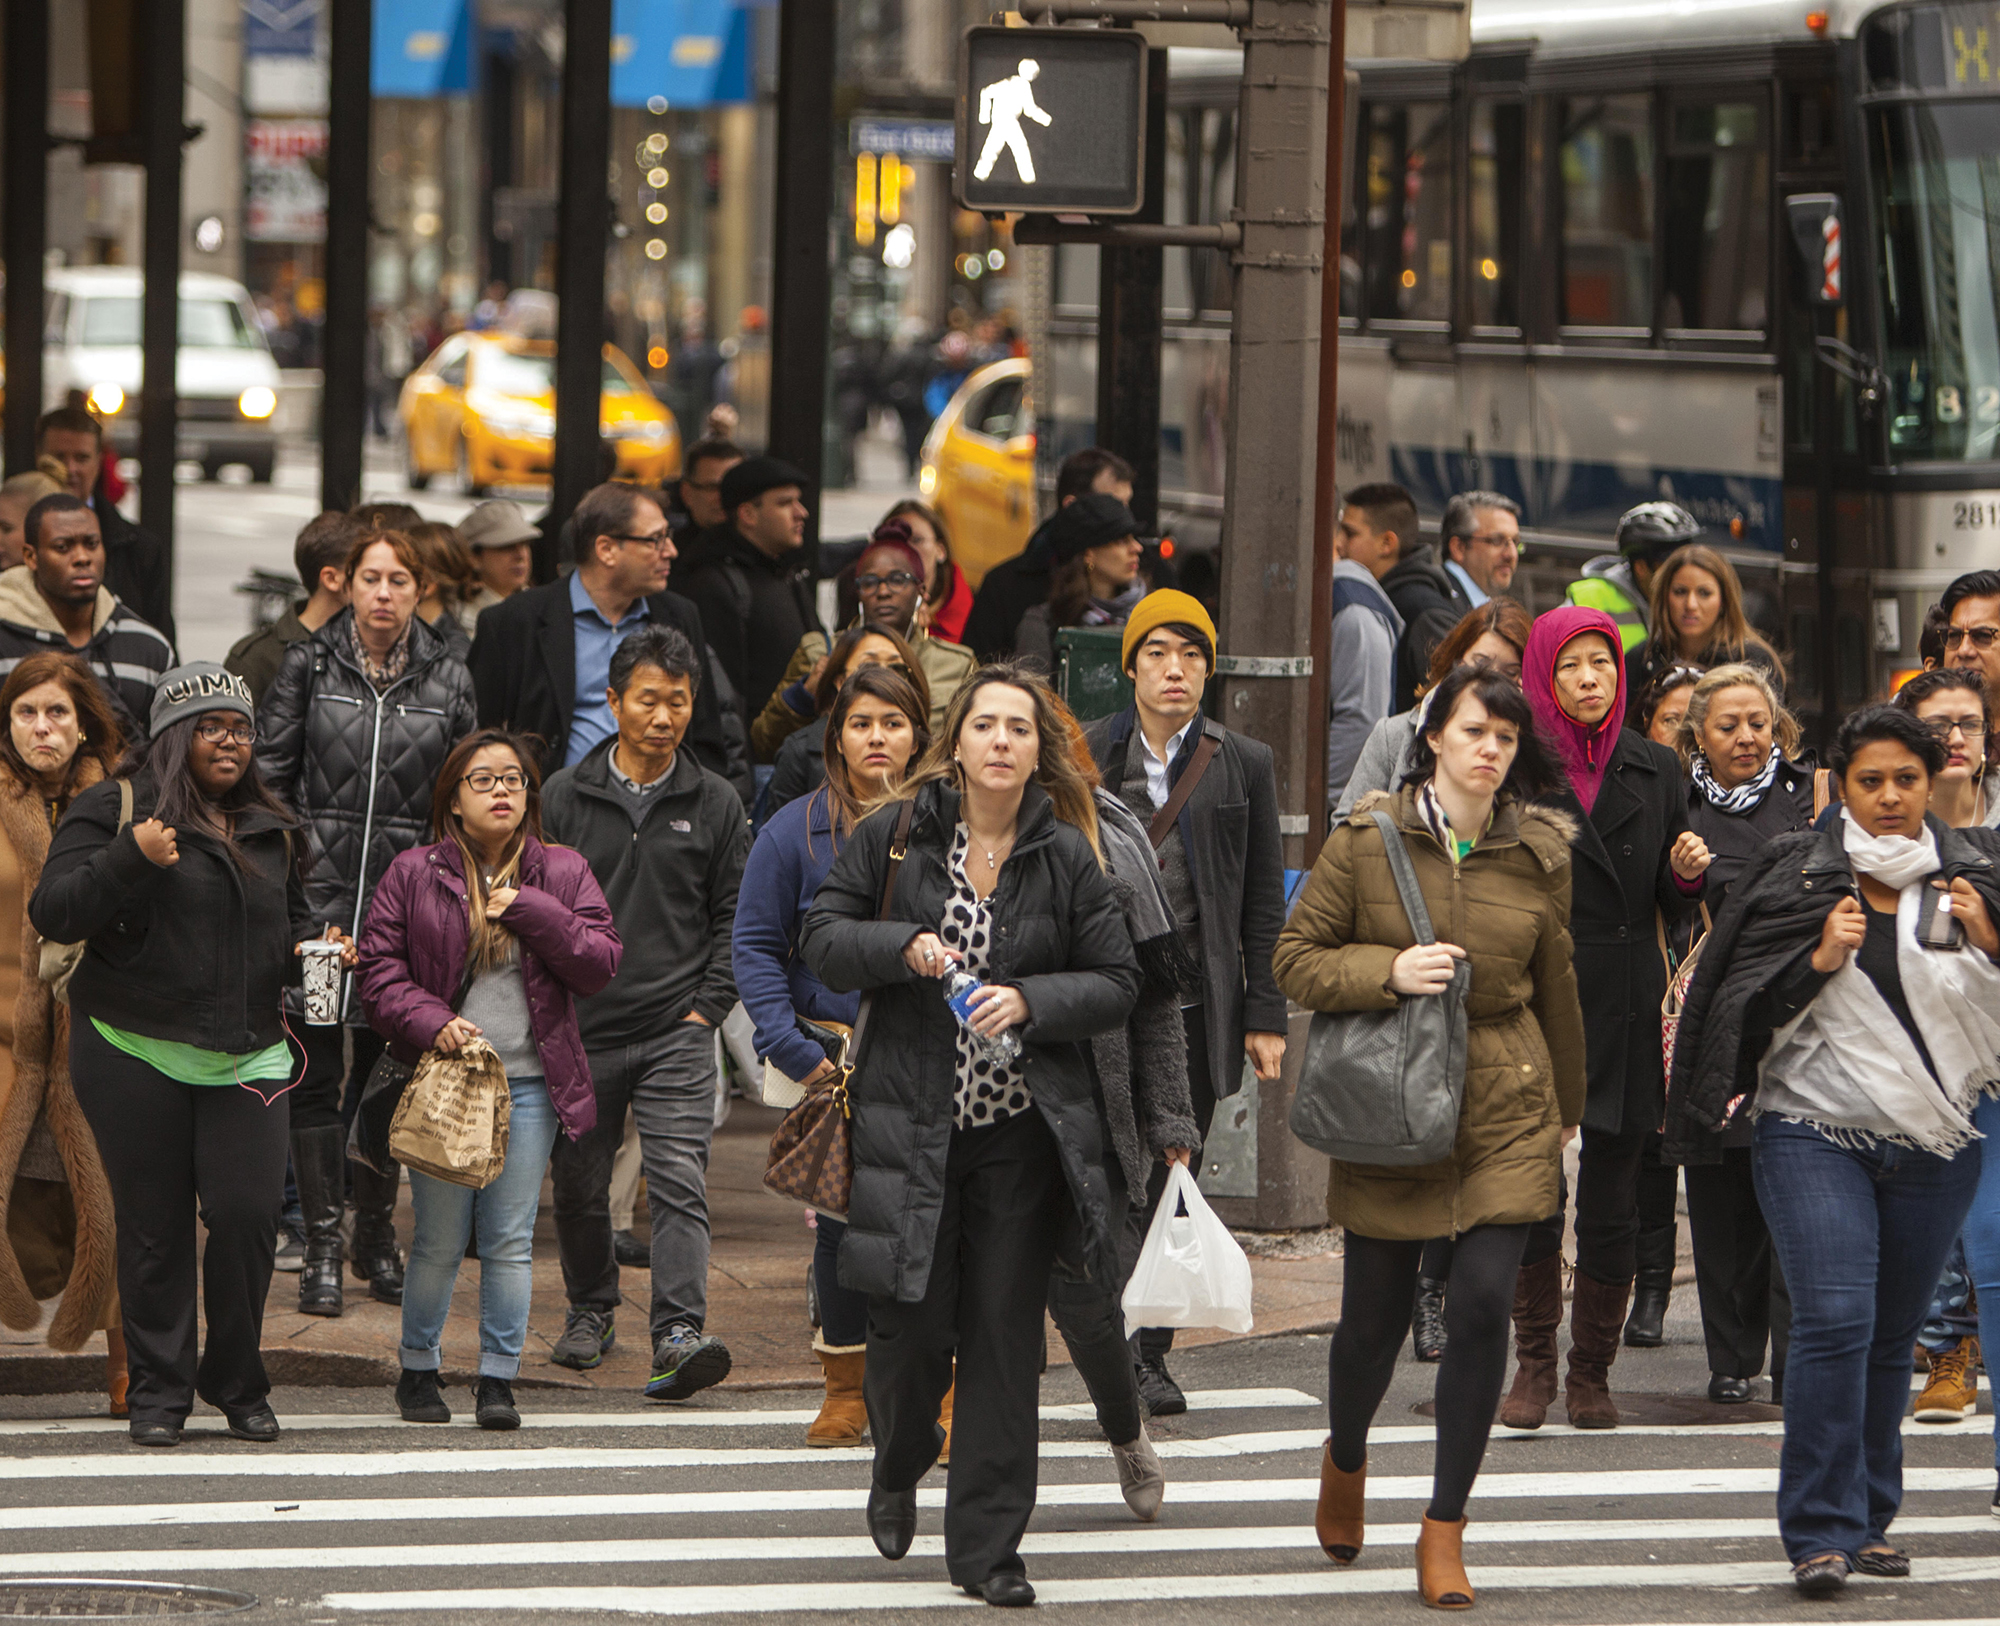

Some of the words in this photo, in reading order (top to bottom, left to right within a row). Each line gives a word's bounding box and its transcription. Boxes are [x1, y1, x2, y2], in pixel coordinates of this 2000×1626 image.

[1953, 25, 2000, 82] X
[1954, 501, 2000, 530] 281
[433, 1091, 442, 1101] do
[426, 1100, 439, 1113] the
[441, 1121, 453, 1131] we
